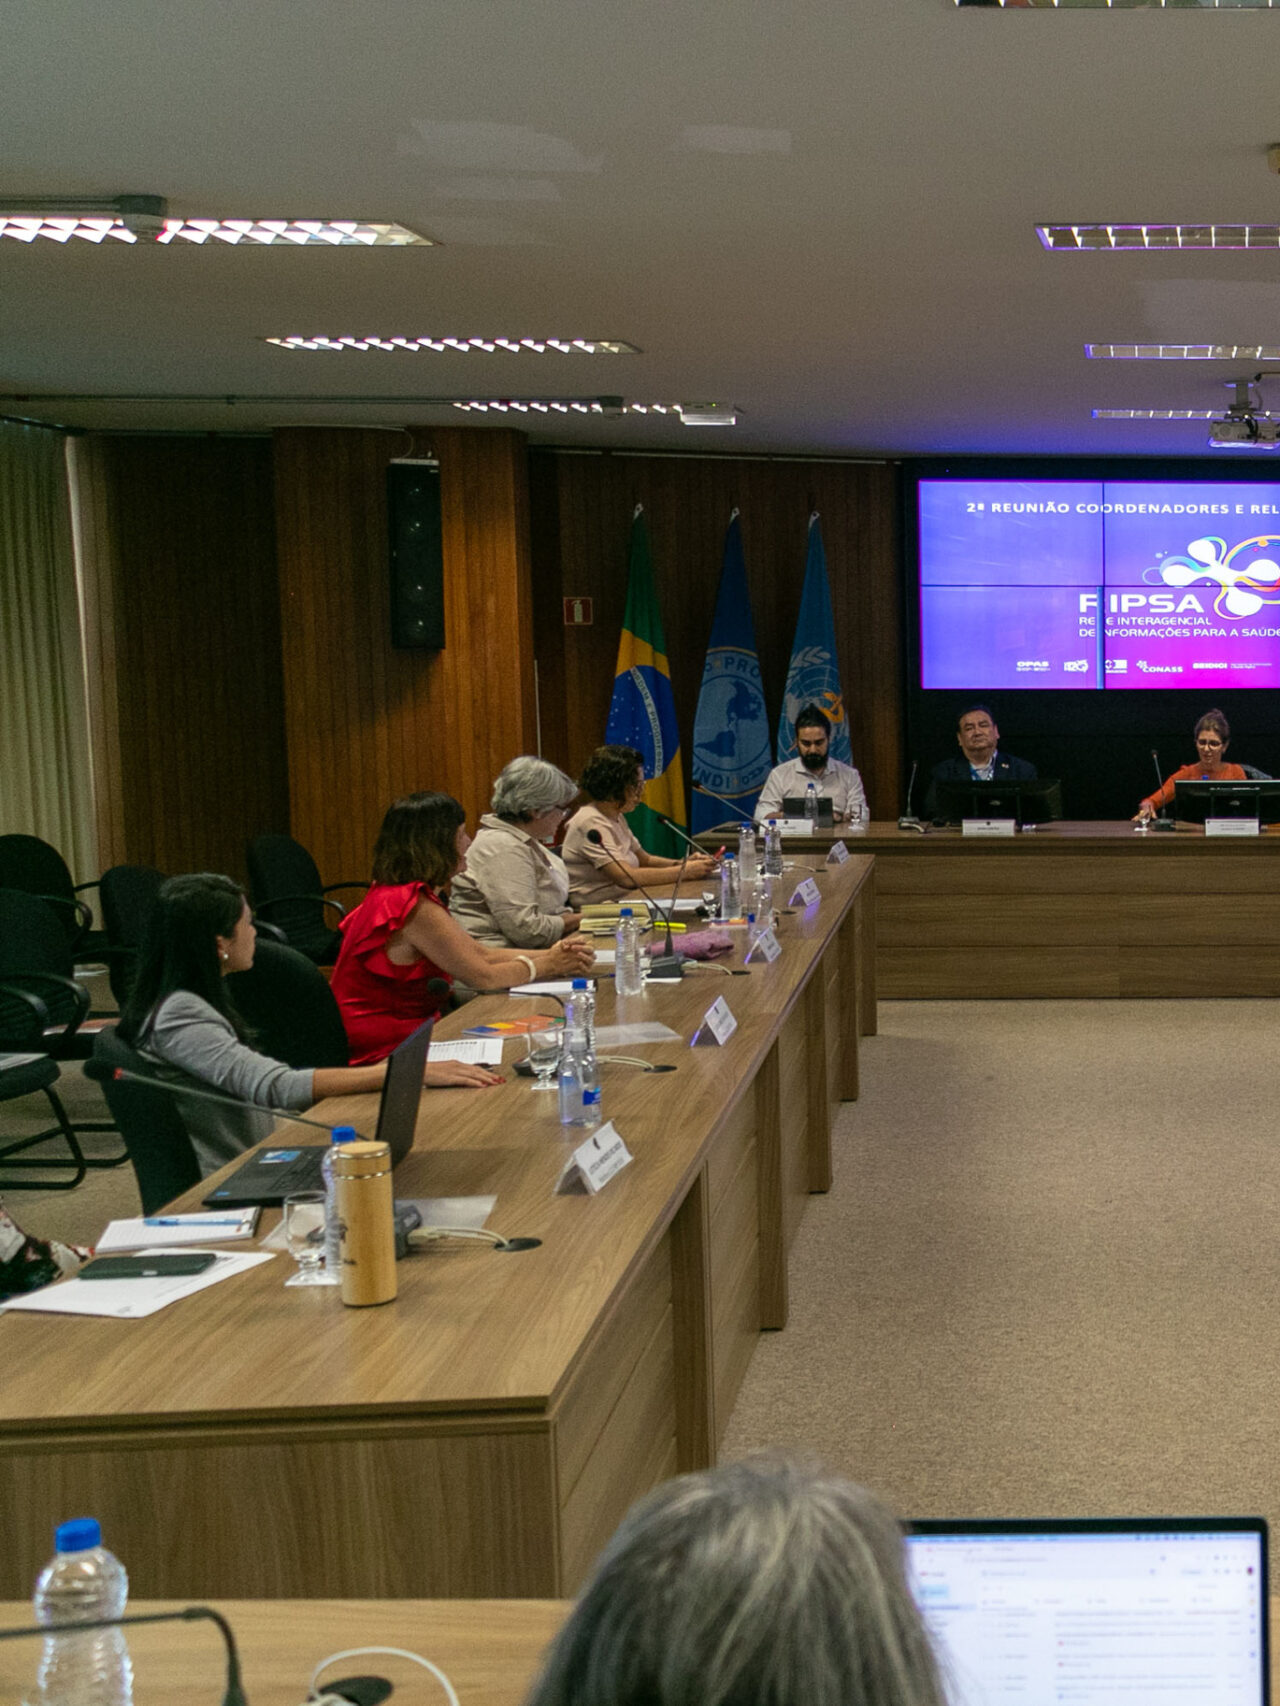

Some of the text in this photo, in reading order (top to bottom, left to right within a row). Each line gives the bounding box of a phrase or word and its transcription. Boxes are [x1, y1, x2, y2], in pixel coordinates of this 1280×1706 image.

[991, 500, 1070, 514] REUNIÃO
[1075, 503, 1230, 515] COORDENADORES
[1235, 504, 1245, 514] E
[1079, 616, 1213, 626] REE INTERAGENCIAL
[1079, 628, 1096, 637] DE
[1193, 628, 1227, 637] PARA
[1229, 628, 1239, 637] A
[1142, 665, 1183, 673] CONASS
